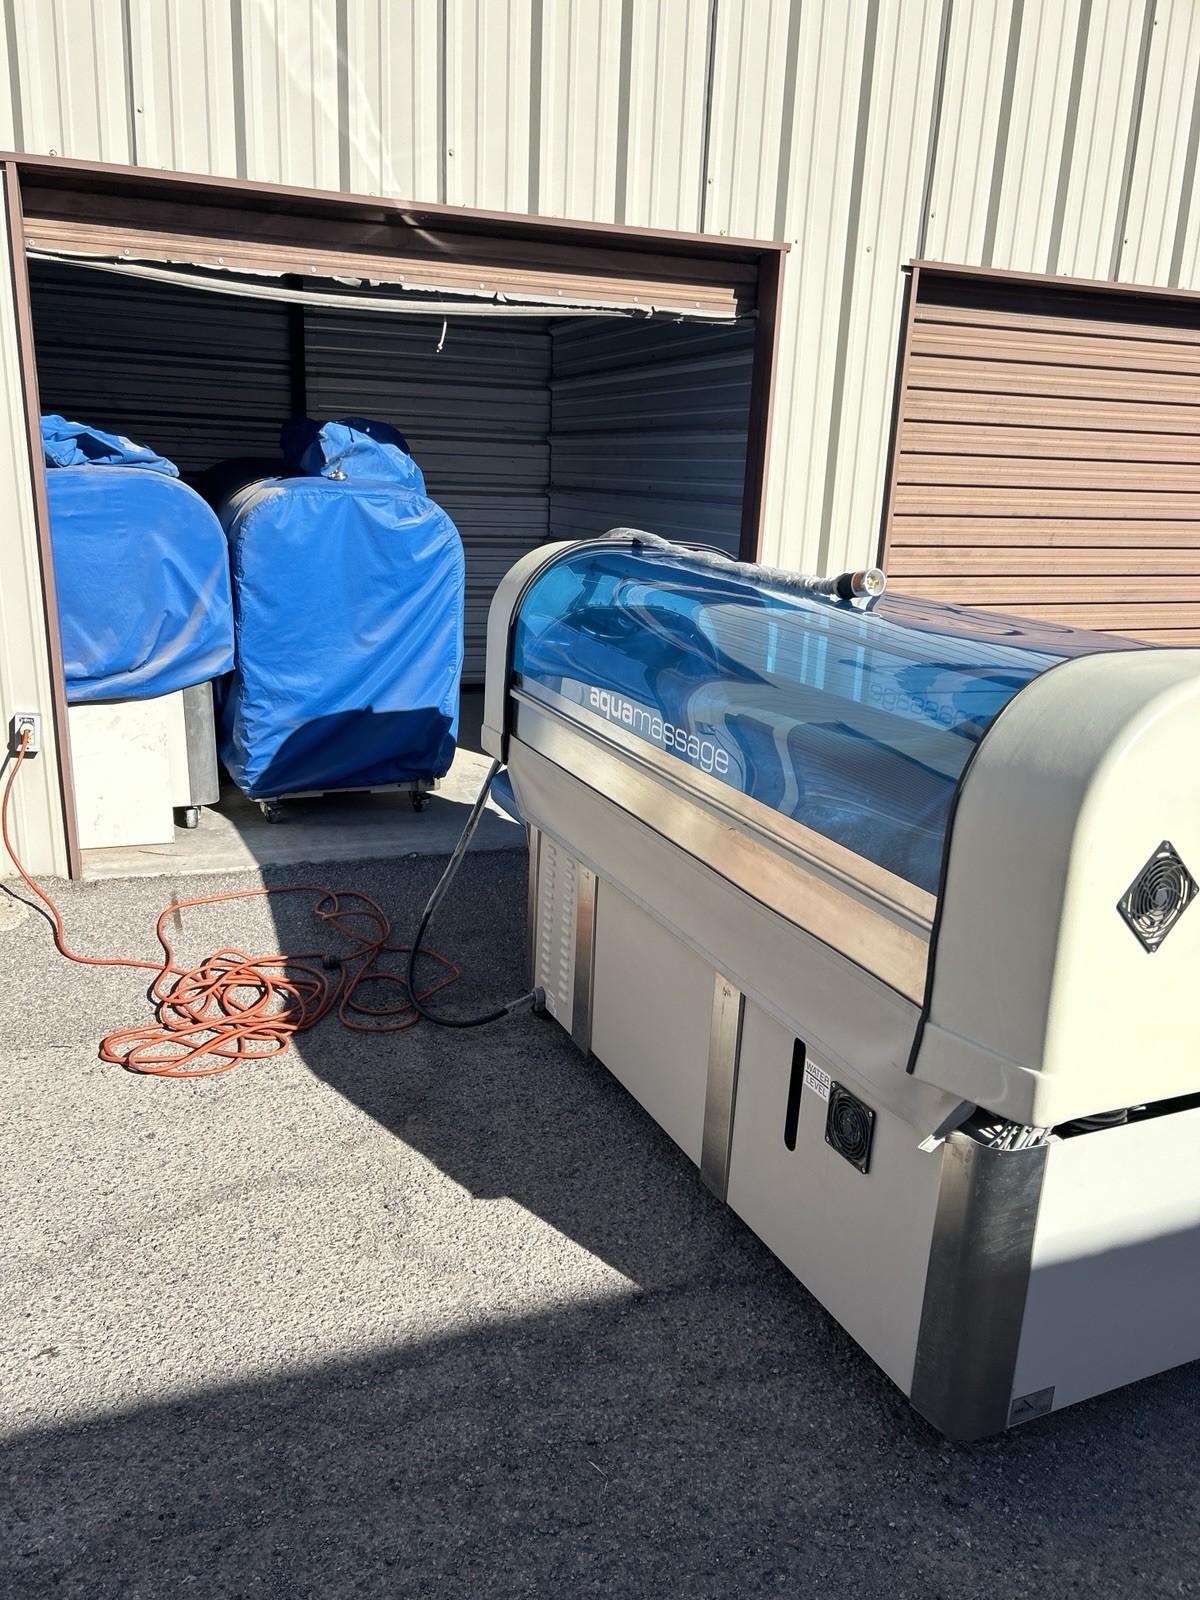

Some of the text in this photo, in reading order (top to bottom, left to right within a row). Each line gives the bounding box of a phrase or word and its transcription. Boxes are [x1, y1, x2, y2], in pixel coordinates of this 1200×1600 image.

[589, 686, 729, 774] aquamassage
[805, 1074, 827, 1098] LEVEL
[806, 1061, 829, 1086] WATER
